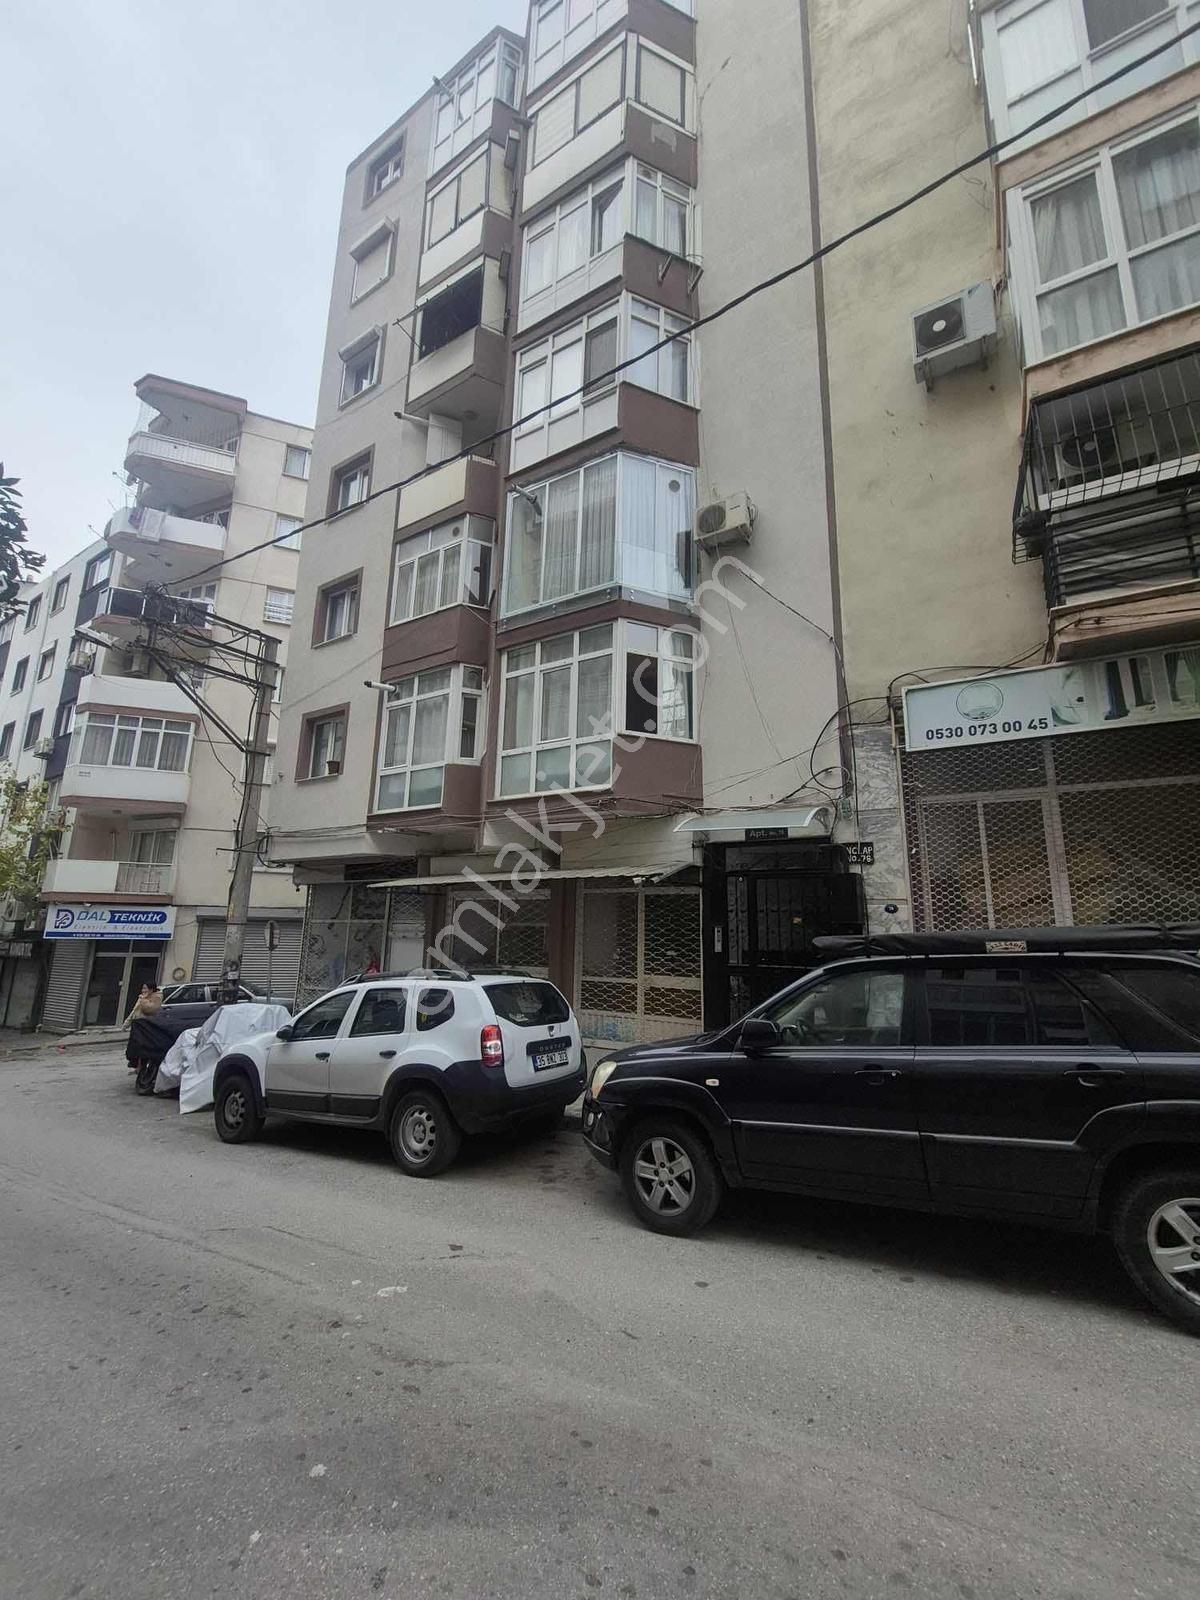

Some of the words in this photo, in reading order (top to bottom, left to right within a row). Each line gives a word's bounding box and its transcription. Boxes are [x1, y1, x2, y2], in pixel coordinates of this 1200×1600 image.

[926, 726, 964, 741] 0530
[968, 723, 998, 737] 073
[1002, 720, 1022, 733] 00
[1027, 717, 1048, 730] 45
[76, 910, 108, 921] DAL
[113, 911, 162, 922] TEKNİK
